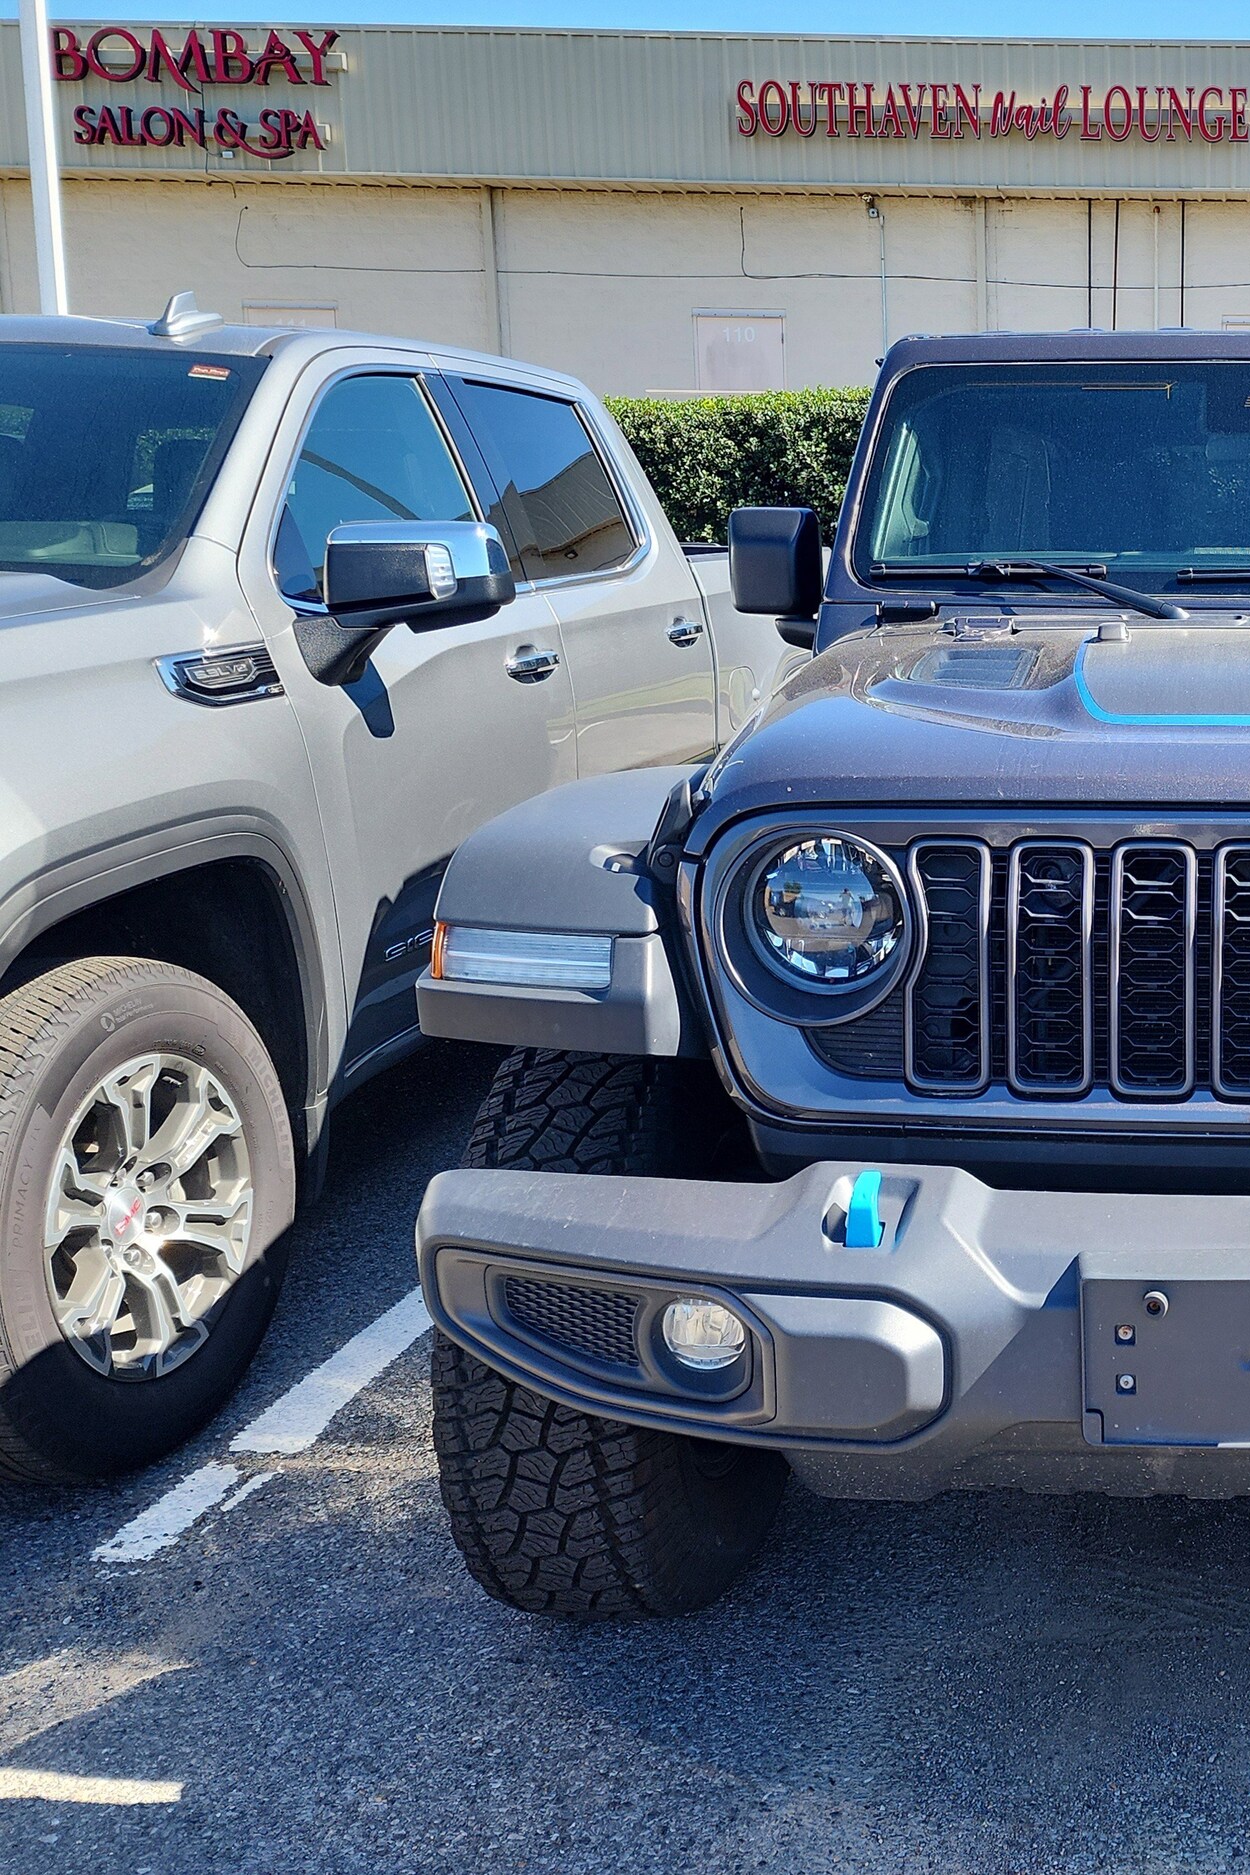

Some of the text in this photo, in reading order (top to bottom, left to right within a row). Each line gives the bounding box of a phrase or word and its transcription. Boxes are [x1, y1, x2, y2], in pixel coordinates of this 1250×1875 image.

[51, 27, 340, 93] BOMBAY
[73, 105, 327, 159] SALON & SPA
[737, 79, 1250, 142] SOUTHAVEN Nail LOUNGE
[722, 327, 756, 342] 110
